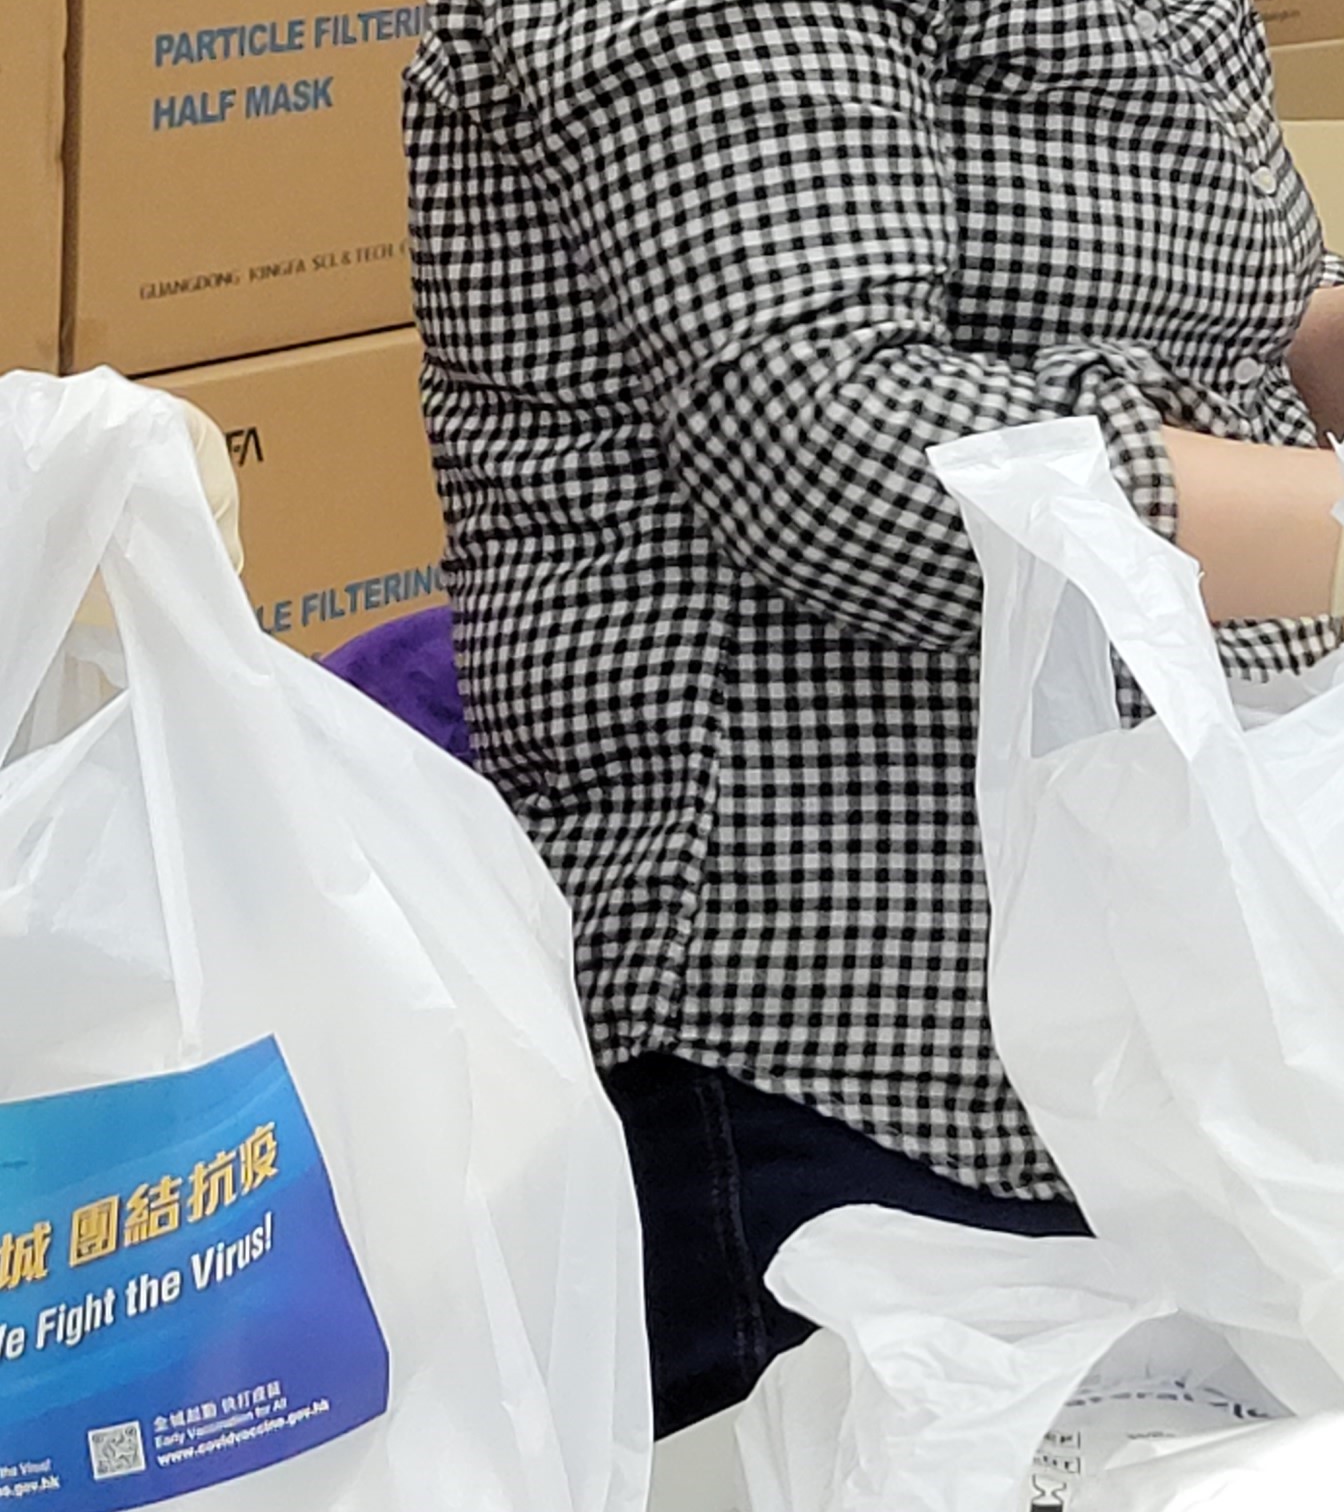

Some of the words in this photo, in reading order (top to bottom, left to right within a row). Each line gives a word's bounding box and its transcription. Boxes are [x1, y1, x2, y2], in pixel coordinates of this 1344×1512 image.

[154, 19, 306, 68] PARTICLE
[153, 89, 236, 131] HALF
[245, 76, 334, 119] MASK
[139, 269, 241, 301] GUANGDONG
[248, 258, 306, 282] KINGFA
[68, 1121, 279, 1269] 團結抗疫
[35, 1287, 117, 1350] Fight
[125, 1269, 182, 1318] the
[190, 1210, 273, 1291] Virus!
